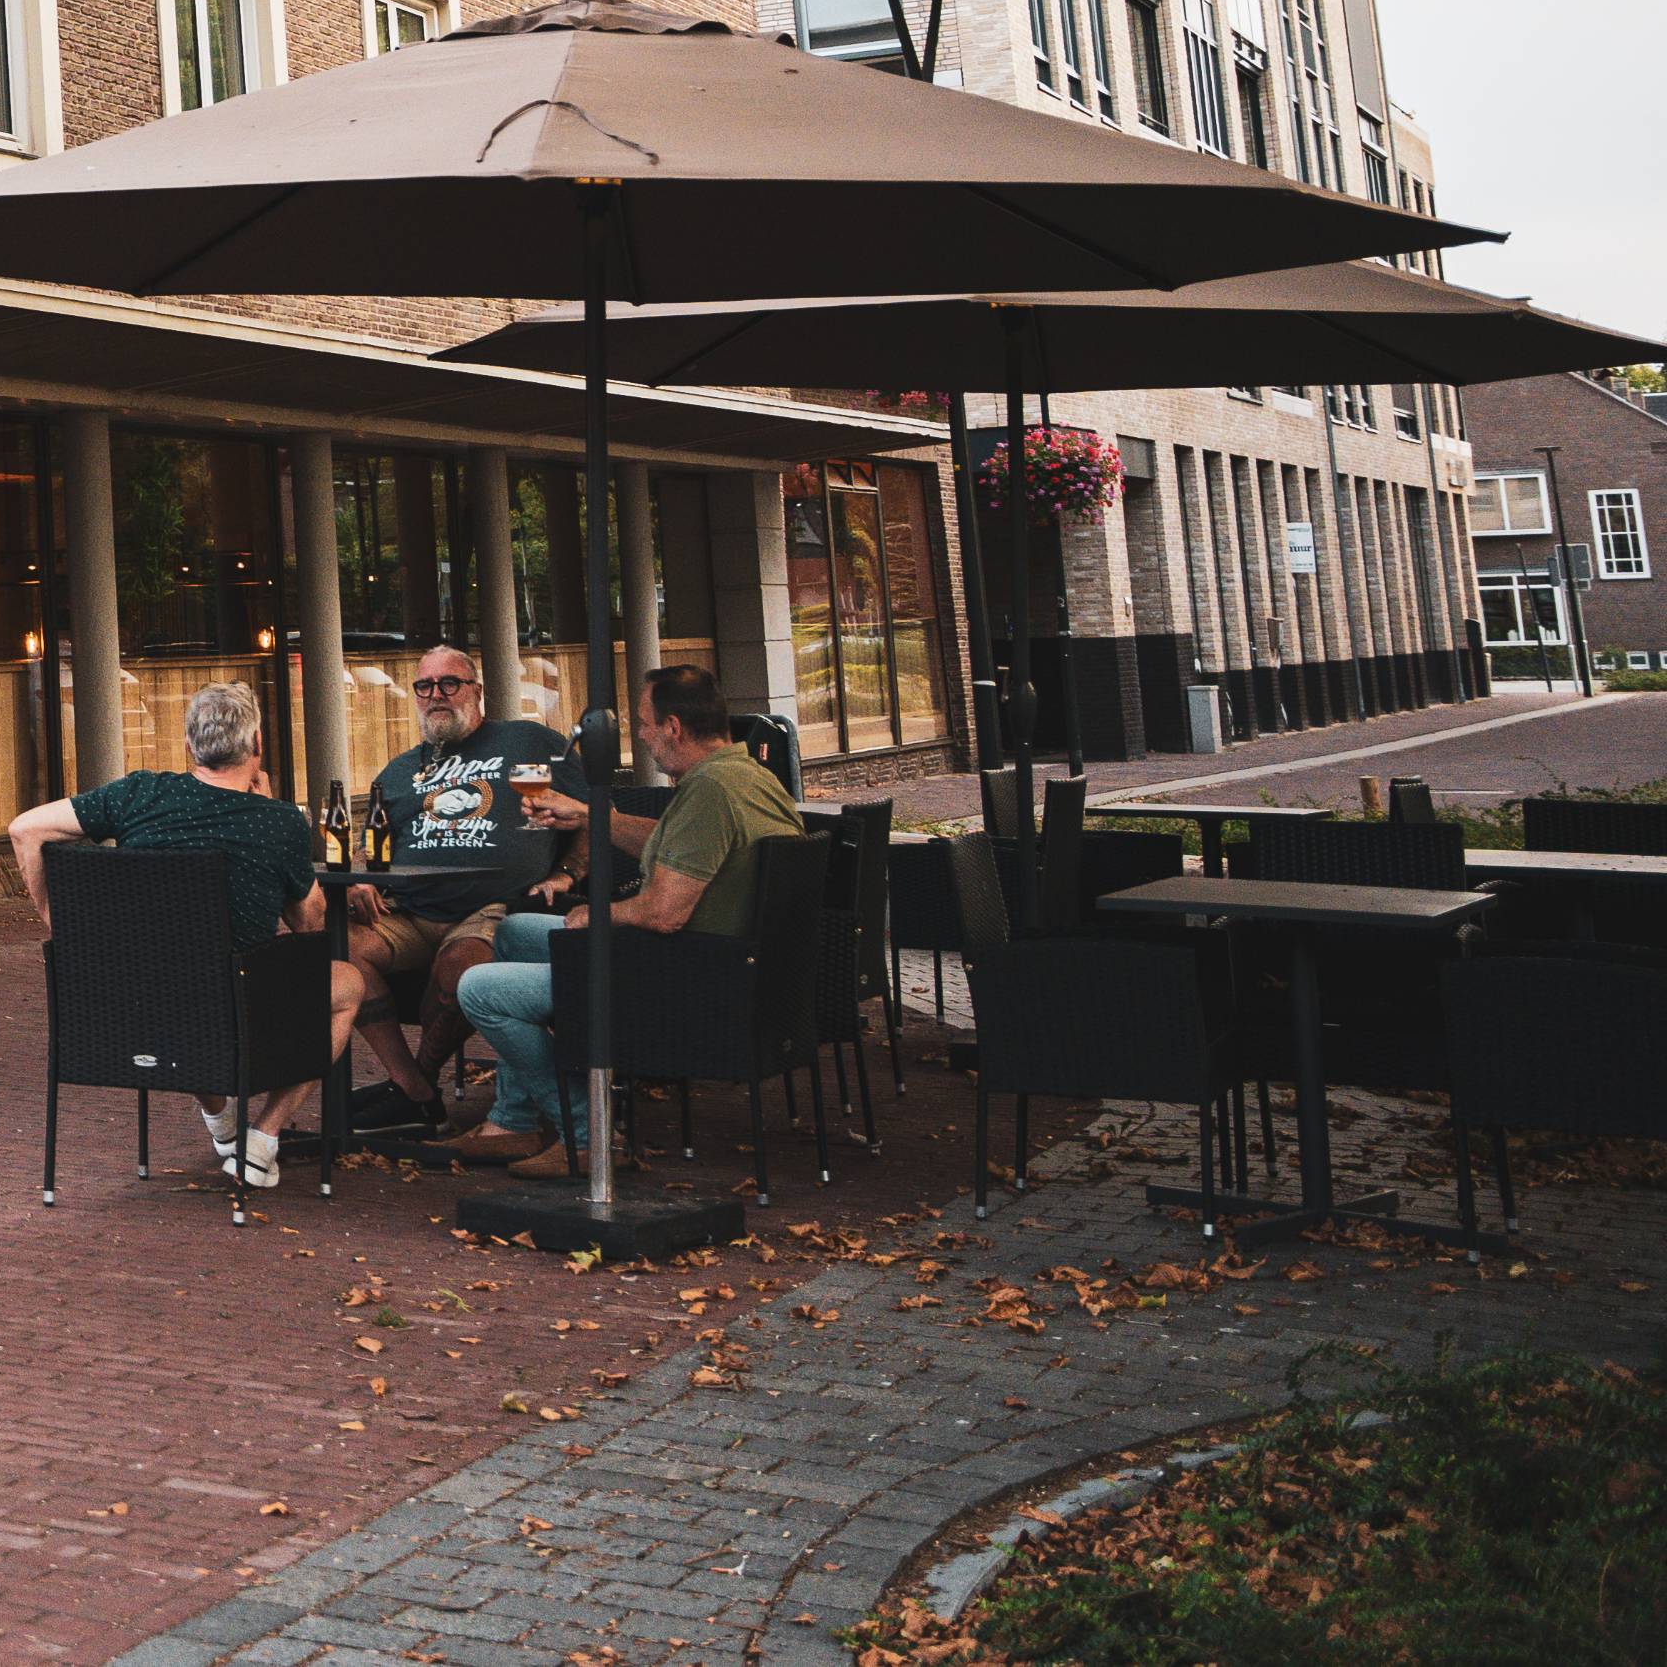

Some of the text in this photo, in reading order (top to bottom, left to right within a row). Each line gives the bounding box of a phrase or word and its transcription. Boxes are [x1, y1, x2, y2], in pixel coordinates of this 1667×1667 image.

[412, 755, 505, 788] Papa
[442, 780, 453, 788] IS
[456, 774, 478, 786] EEN
[480, 771, 502, 780] EER
[444, 830, 454, 838] IS
[417, 837, 484, 850] EEN ZEGEN
